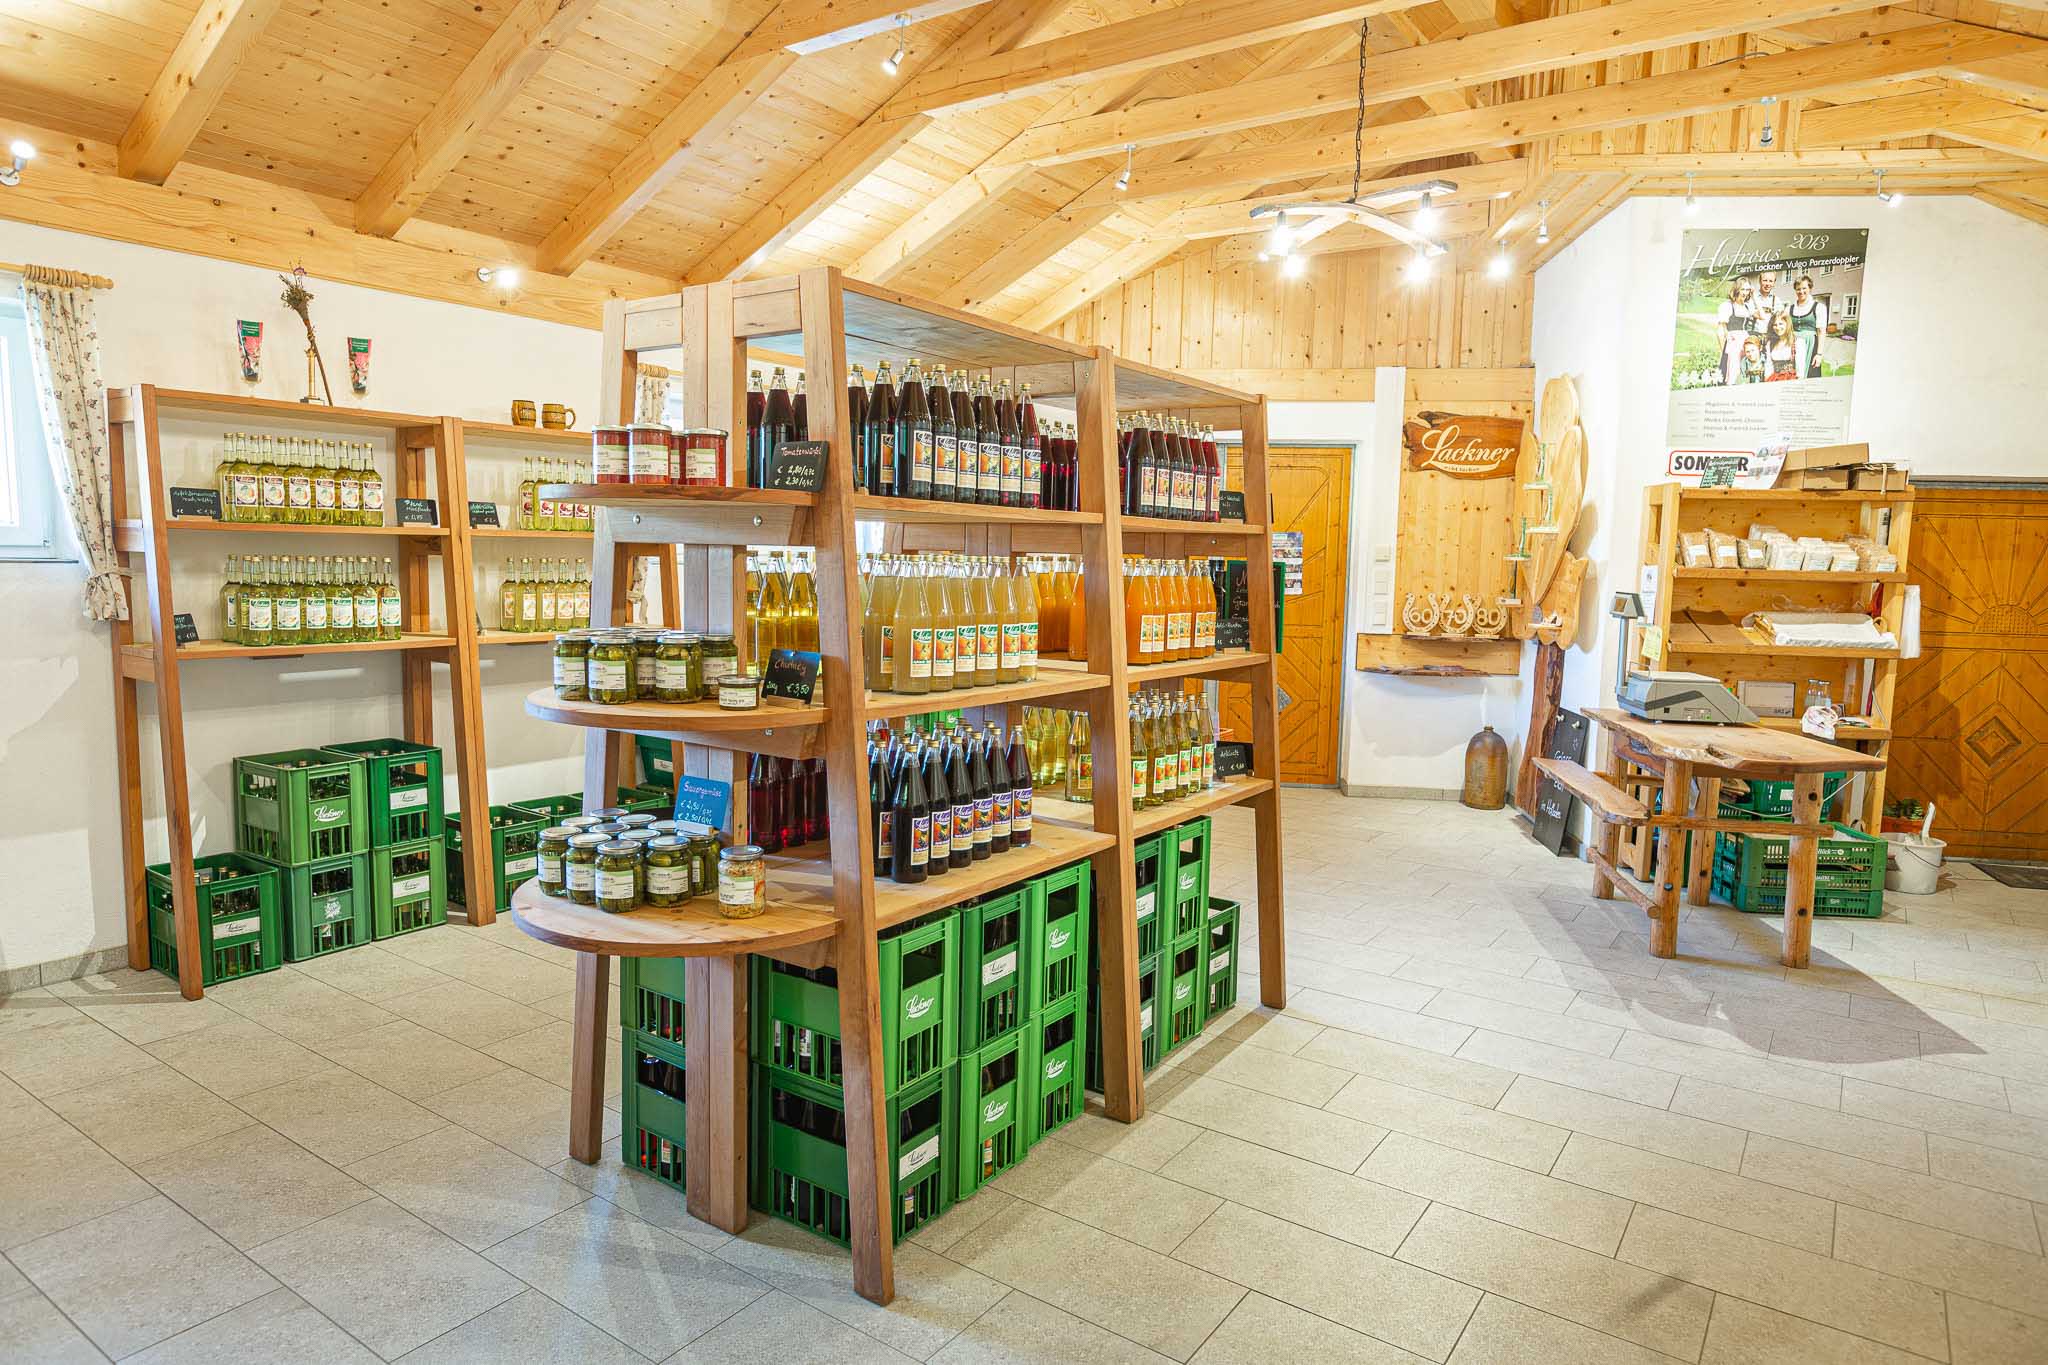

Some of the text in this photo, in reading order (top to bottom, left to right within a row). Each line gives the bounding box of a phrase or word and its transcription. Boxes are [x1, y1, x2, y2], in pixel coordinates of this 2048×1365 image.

[1786, 232, 1830, 250] 2013
[1735, 264, 1752, 273] Fam.
[1754, 262, 1783, 272] Lackner
[1786, 260, 1807, 269] Vulgo
[1421, 425, 1515, 471] Lackner
[1674, 455, 1749, 471] SOMR
